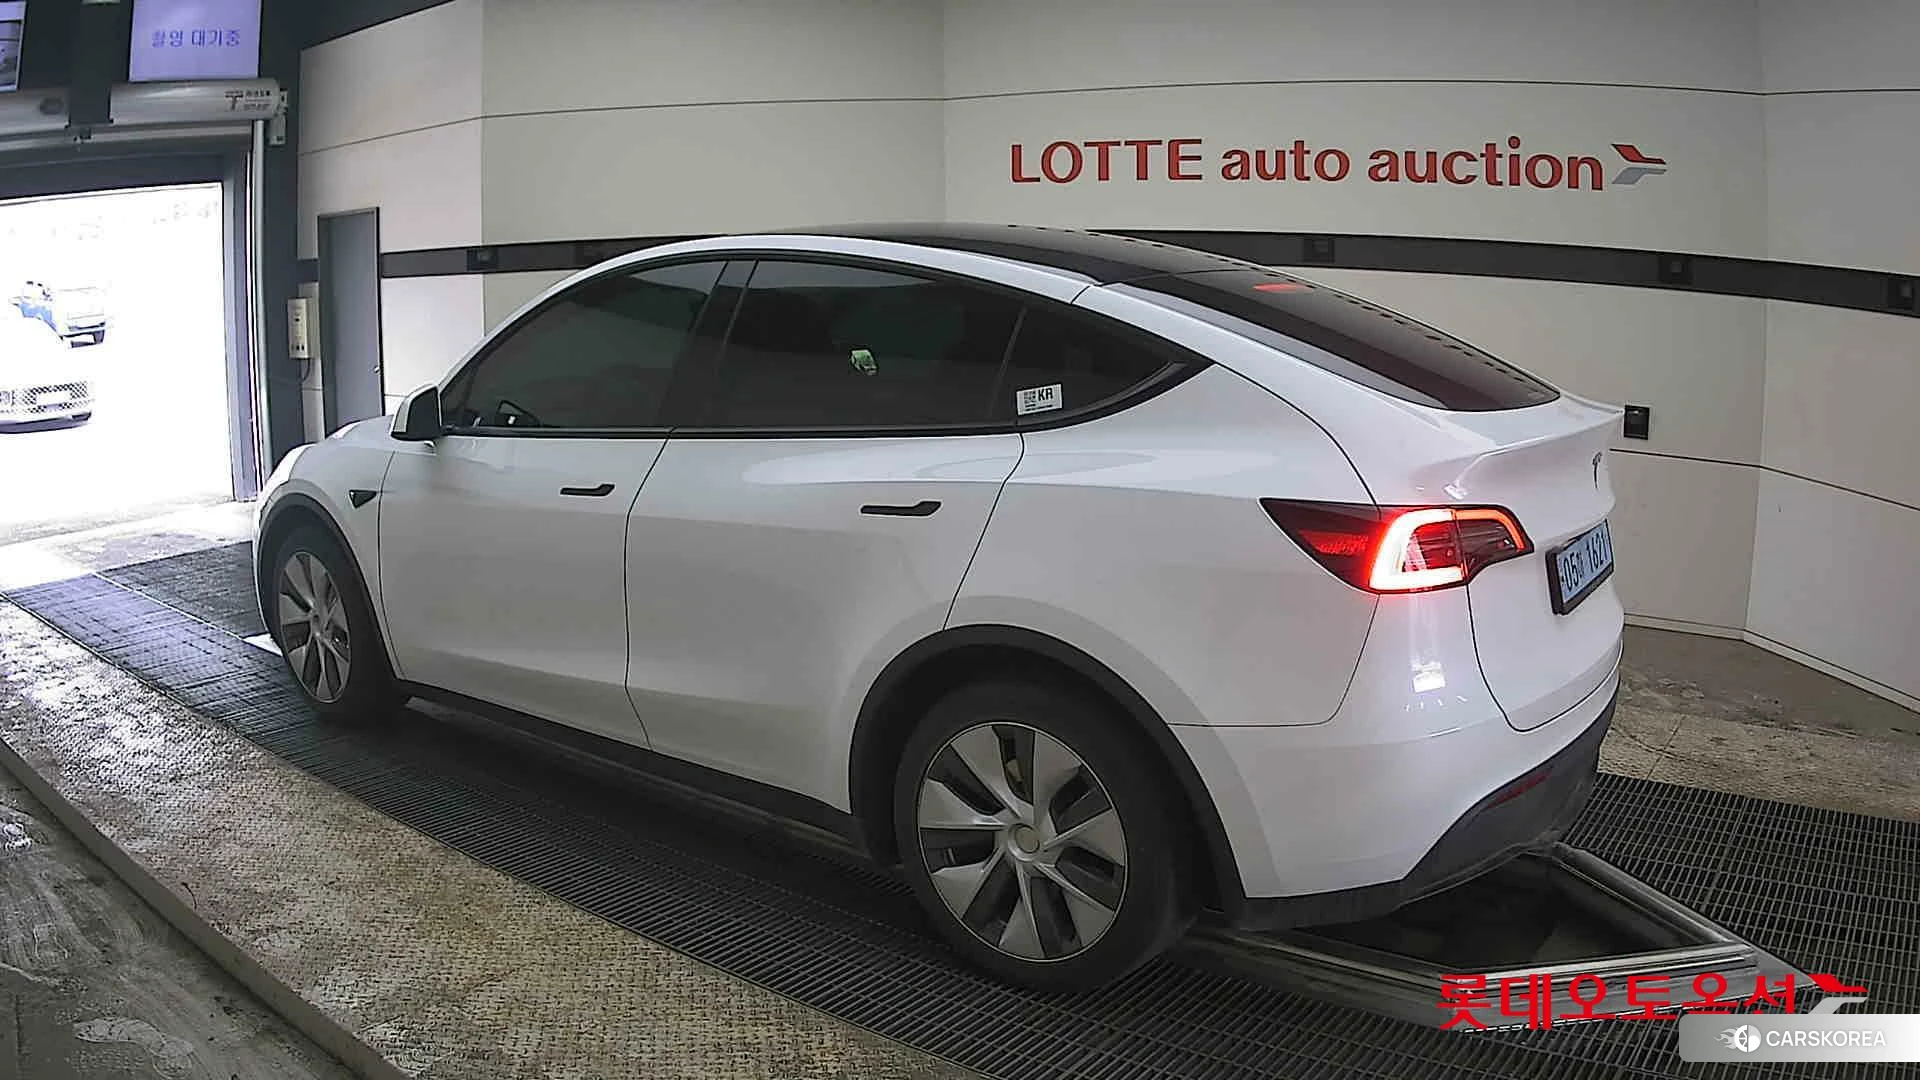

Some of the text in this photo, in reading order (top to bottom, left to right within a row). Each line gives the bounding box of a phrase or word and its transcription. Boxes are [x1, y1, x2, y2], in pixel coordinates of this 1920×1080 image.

[191, 27, 241, 48] 대기중
[1010, 135, 1604, 191] LOTTE auto auction
[1586, 530, 1608, 573] 1621
